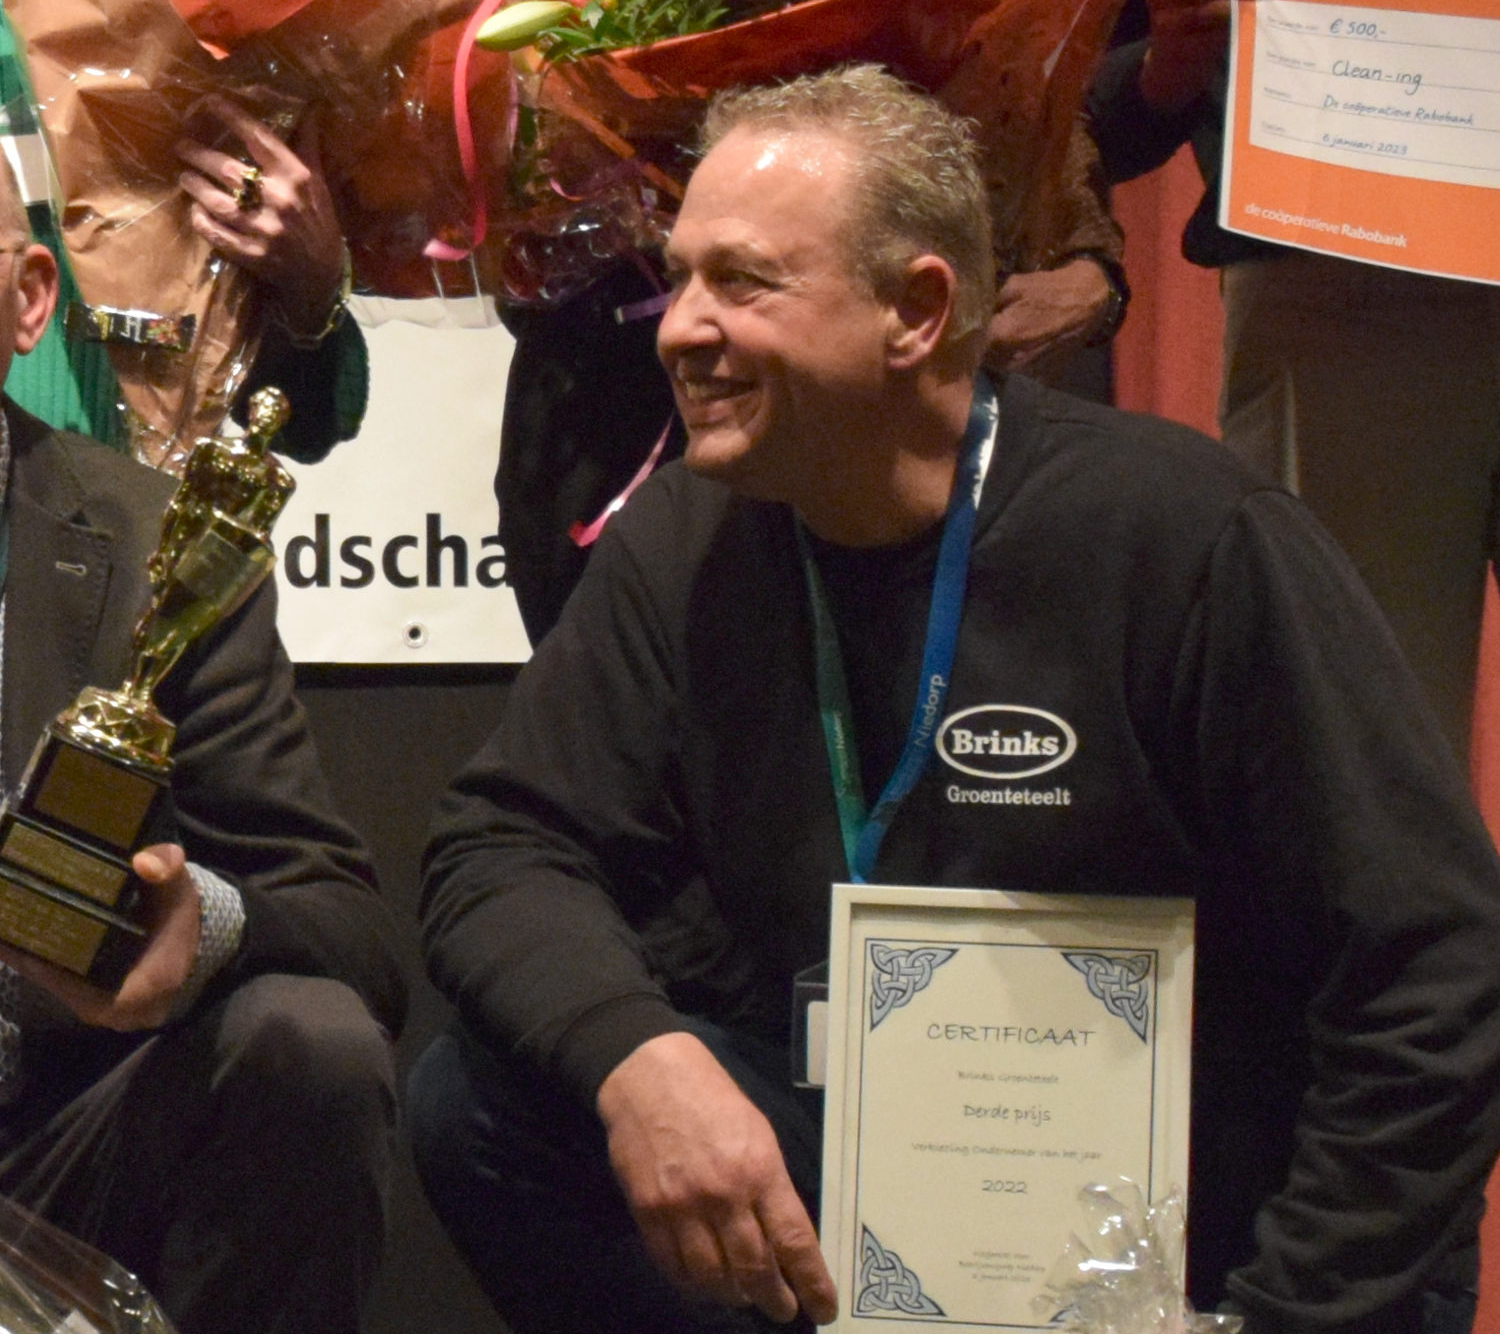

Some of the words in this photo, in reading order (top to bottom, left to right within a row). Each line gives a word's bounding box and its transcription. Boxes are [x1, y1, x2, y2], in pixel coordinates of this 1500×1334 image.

[1244, 202, 1262, 216] de
[1341, 222, 1408, 249] Rabobank
[951, 729, 1060, 757] Brinks
[947, 784, 1071, 807] Groenteteelt
[927, 1023, 1097, 1047] CERTIFICAAT
[962, 1104, 1010, 1120] Derde
[1013, 1104, 1052, 1128] prijs
[981, 1179, 1029, 1195] 2022
